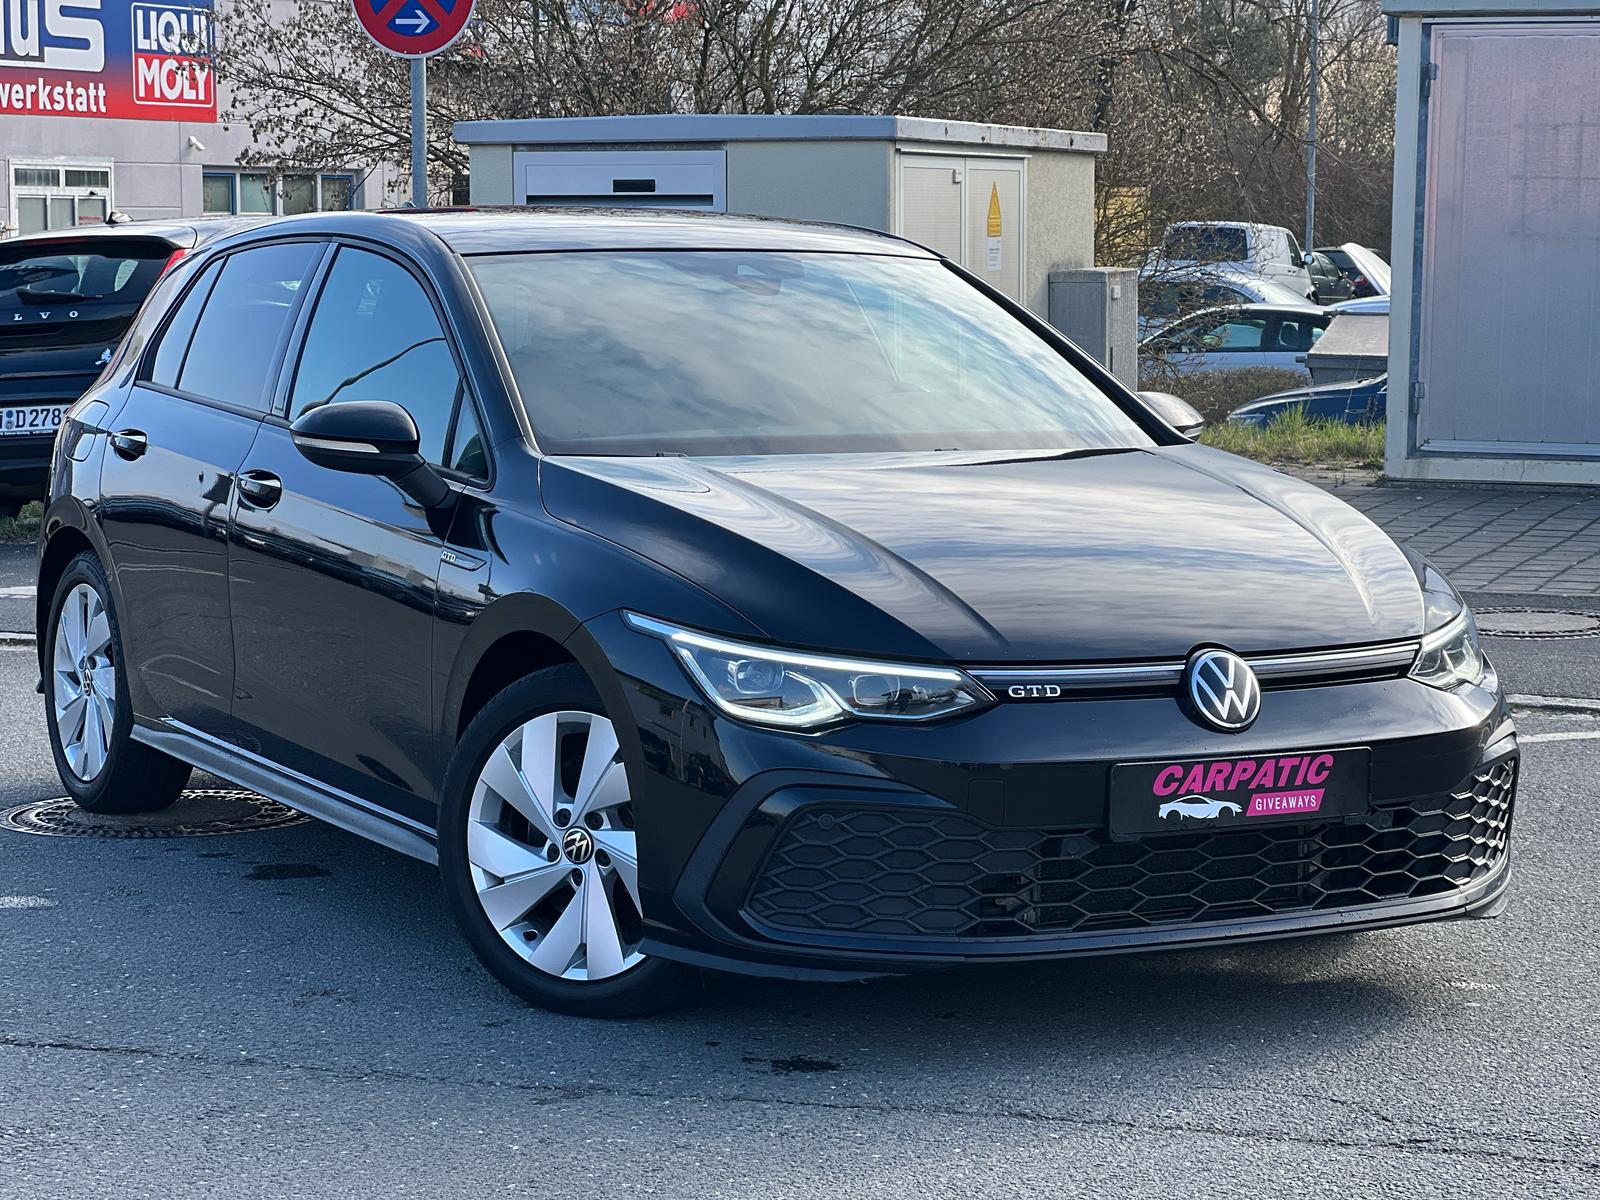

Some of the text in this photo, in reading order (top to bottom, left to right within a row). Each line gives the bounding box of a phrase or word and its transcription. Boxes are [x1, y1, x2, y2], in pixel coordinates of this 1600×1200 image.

[136, 10, 208, 55] LIQUI
[137, 58, 209, 101] MOLY
[441, 550, 456, 562] GTD
[1008, 684, 1062, 698] GTD
[1152, 753, 1334, 797] CARPATIC
[1255, 794, 1317, 812] GIVEAWAYS
